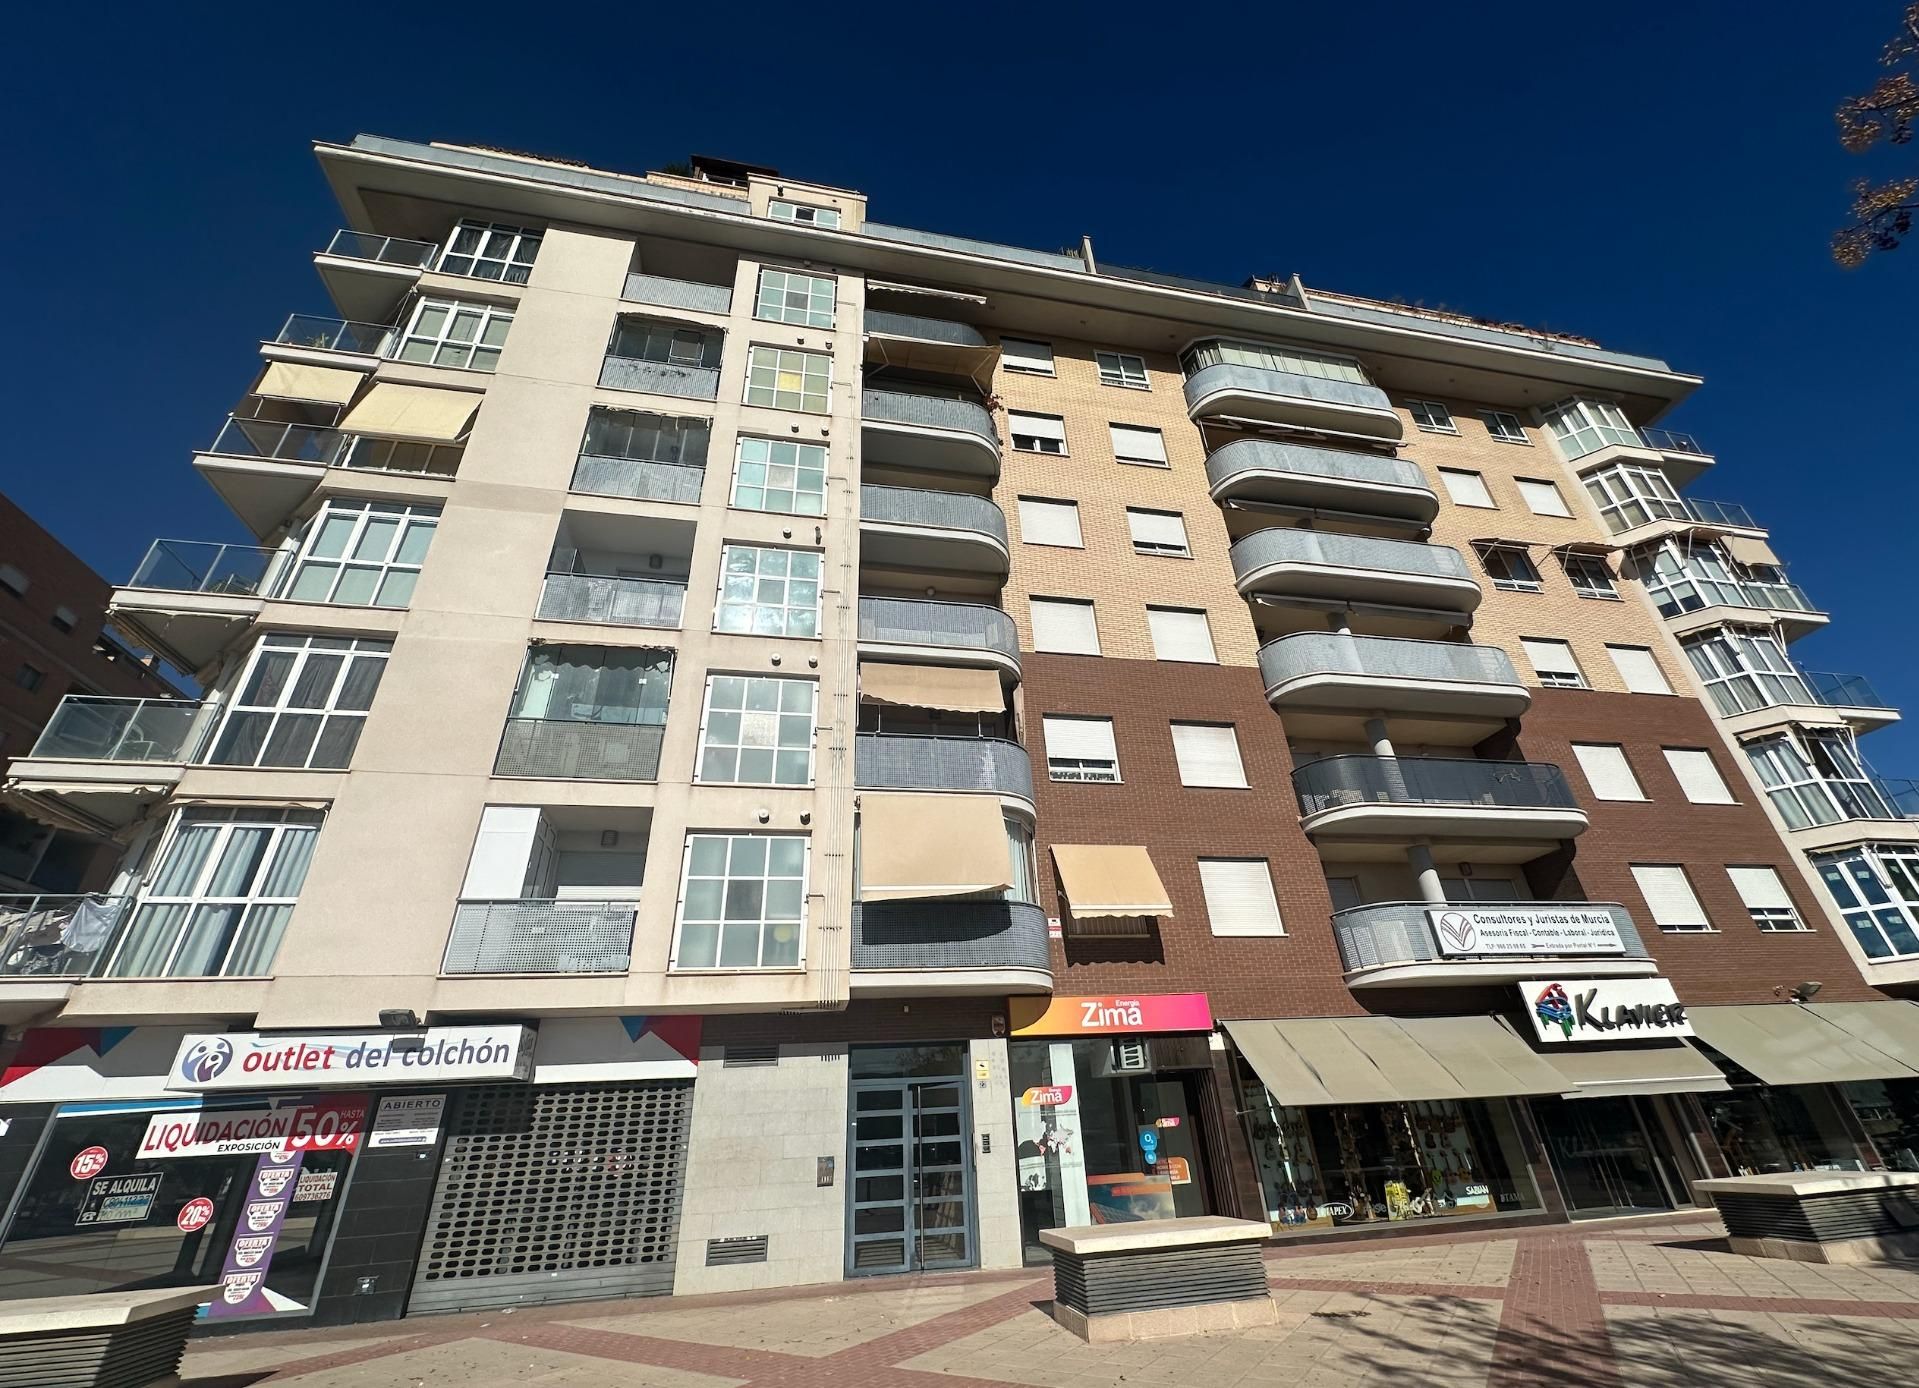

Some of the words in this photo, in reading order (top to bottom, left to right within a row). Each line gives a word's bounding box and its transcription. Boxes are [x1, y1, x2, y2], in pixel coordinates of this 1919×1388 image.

[1472, 913, 1527, 924] Consultores
[1527, 916, 1533, 926] y
[1535, 913, 1569, 924] Juristas
[1569, 913, 1580, 924] de
[1580, 913, 1611, 924] Murcia
[1080, 1001, 1143, 1027] Zima
[242, 1042, 335, 1073] outlet
[345, 1040, 393, 1069] del
[402, 1036, 510, 1067] colchón
[1030, 1090, 1063, 1104] Zima
[384, 1099, 440, 1109] ABIERTO
[340, 1108, 365, 1119] HASTA
[143, 1112, 288, 1152] LIQUIDACIÓN
[291, 1110, 358, 1148] 50%
[216, 1140, 281, 1153] EXPOSICIÓN
[92, 1181, 110, 1196] SE
[108, 1177, 157, 1195] ALQUILA
[298, 1183, 333, 1192] TOTAL
